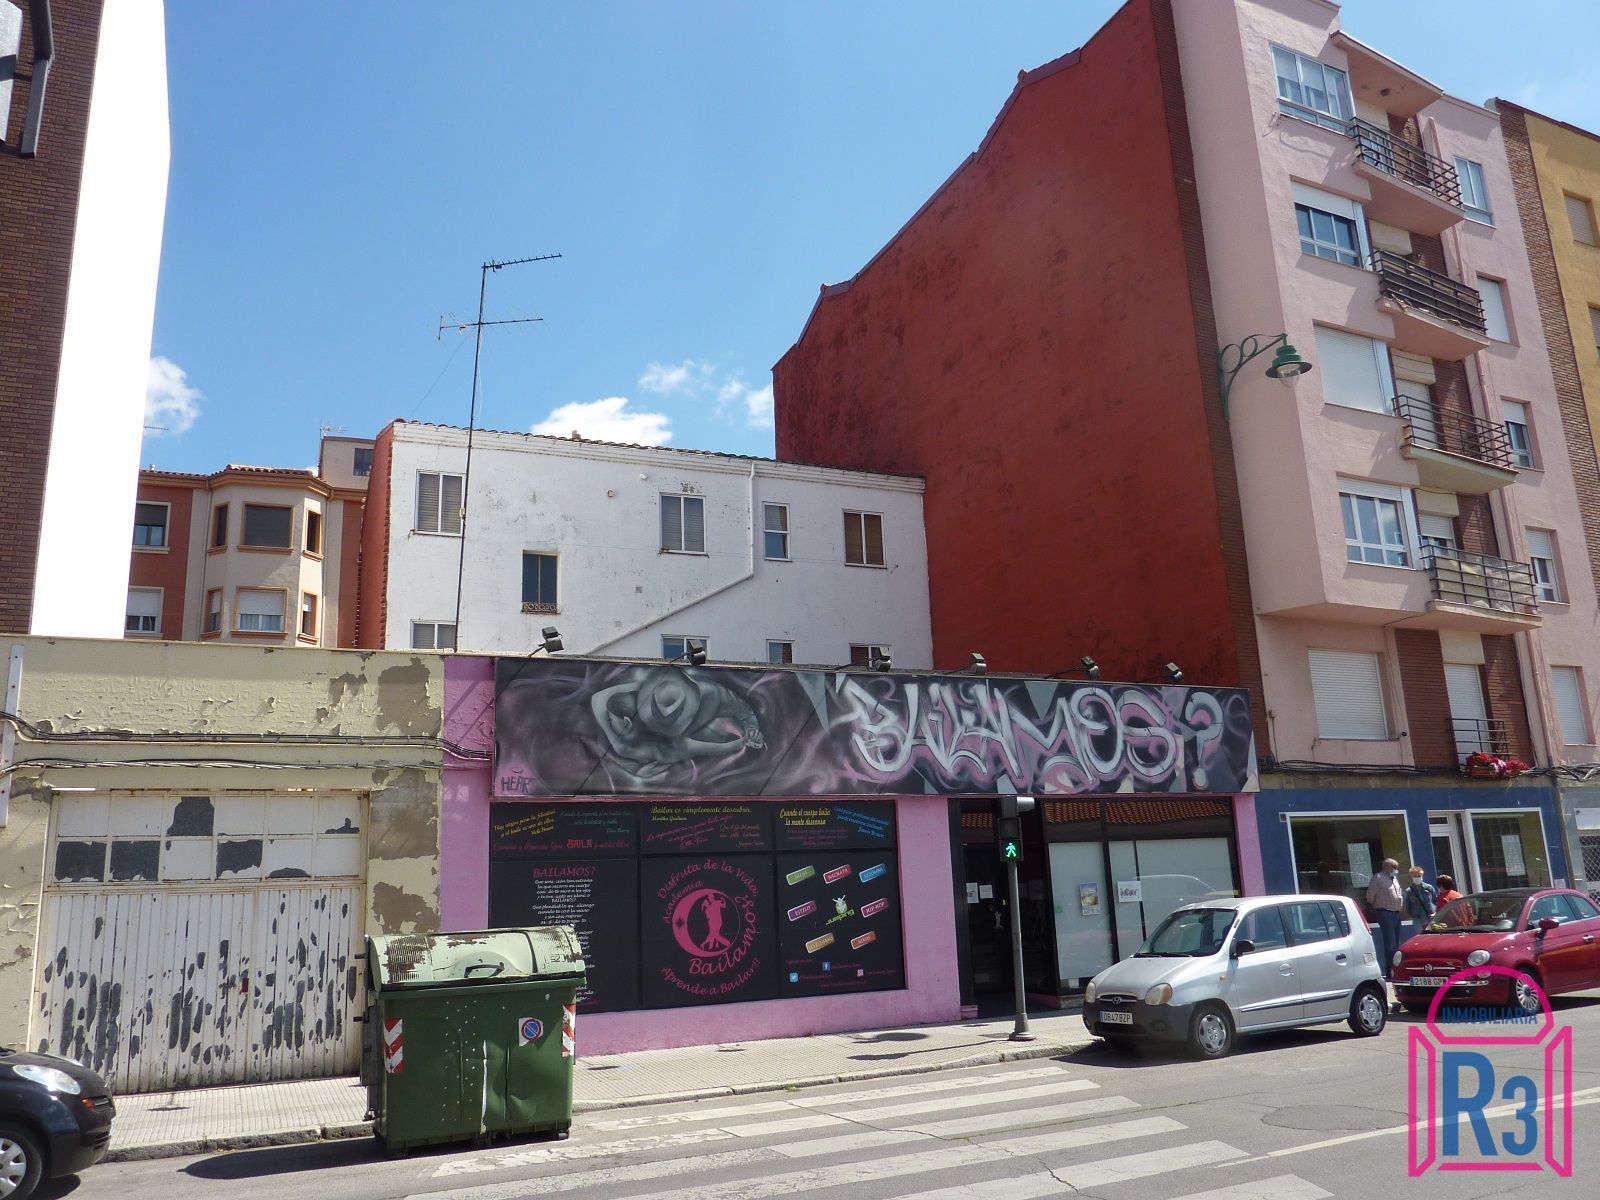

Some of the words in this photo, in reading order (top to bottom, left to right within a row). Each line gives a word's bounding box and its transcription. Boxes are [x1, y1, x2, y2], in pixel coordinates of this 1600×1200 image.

[533, 866, 596, 878] BAILAMOS?
[657, 864, 701, 899] Disfruta
[703, 859, 719, 870] de
[721, 861, 735, 873] la
[663, 880, 704, 924] Academia
[662, 968, 708, 995] Aprende
